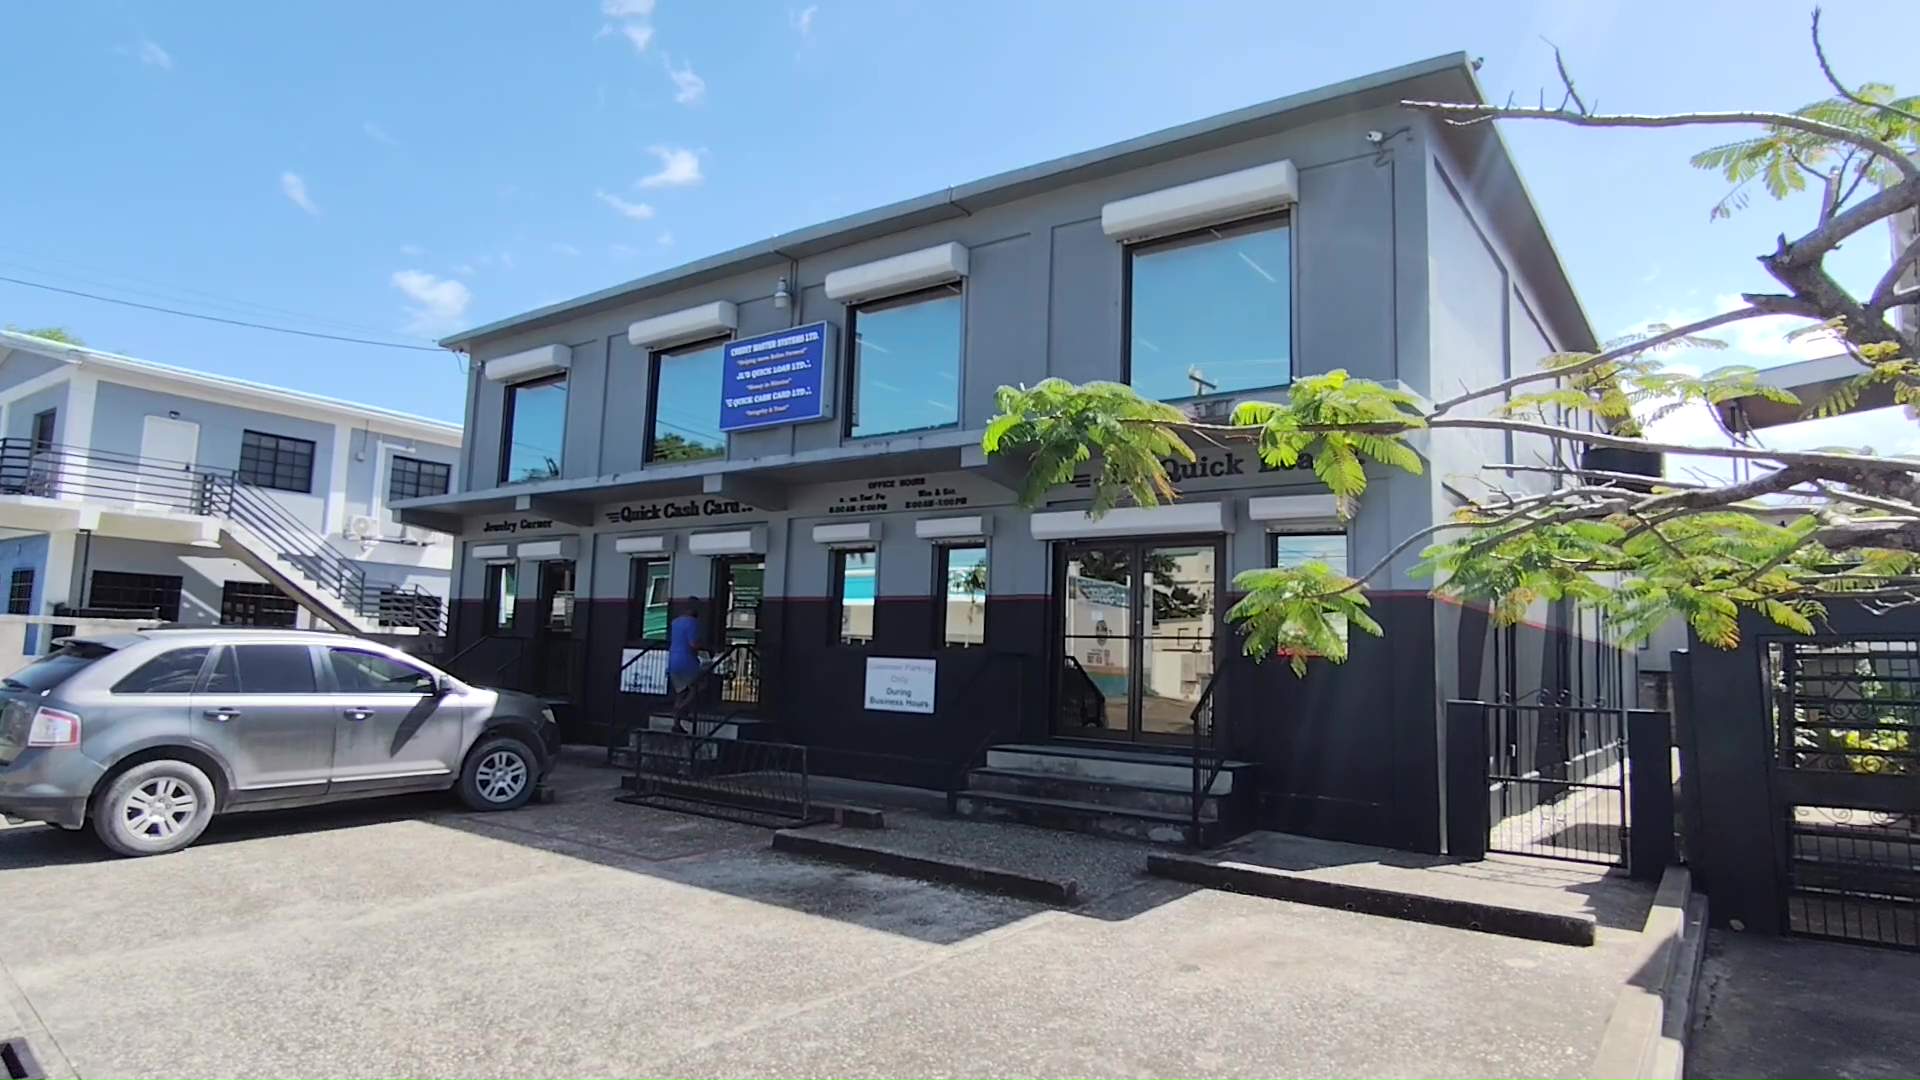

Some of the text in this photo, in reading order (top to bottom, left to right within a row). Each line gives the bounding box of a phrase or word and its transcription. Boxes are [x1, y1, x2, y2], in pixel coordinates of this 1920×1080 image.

[751, 366, 773, 379] QUICK
[773, 363, 791, 374] LOAN
[732, 396, 753, 408] QUICK
[754, 392, 772, 403] CASH
[772, 389, 791, 401] CARD
[1161, 452, 1244, 483] Quick
[868, 480, 895, 490] OFFICE
[621, 503, 662, 523] Quick
[664, 500, 700, 518] Cash
[483, 518, 553, 533] Jewelry Corner
[886, 687, 913, 698] During
[869, 696, 929, 708] Business Hours
